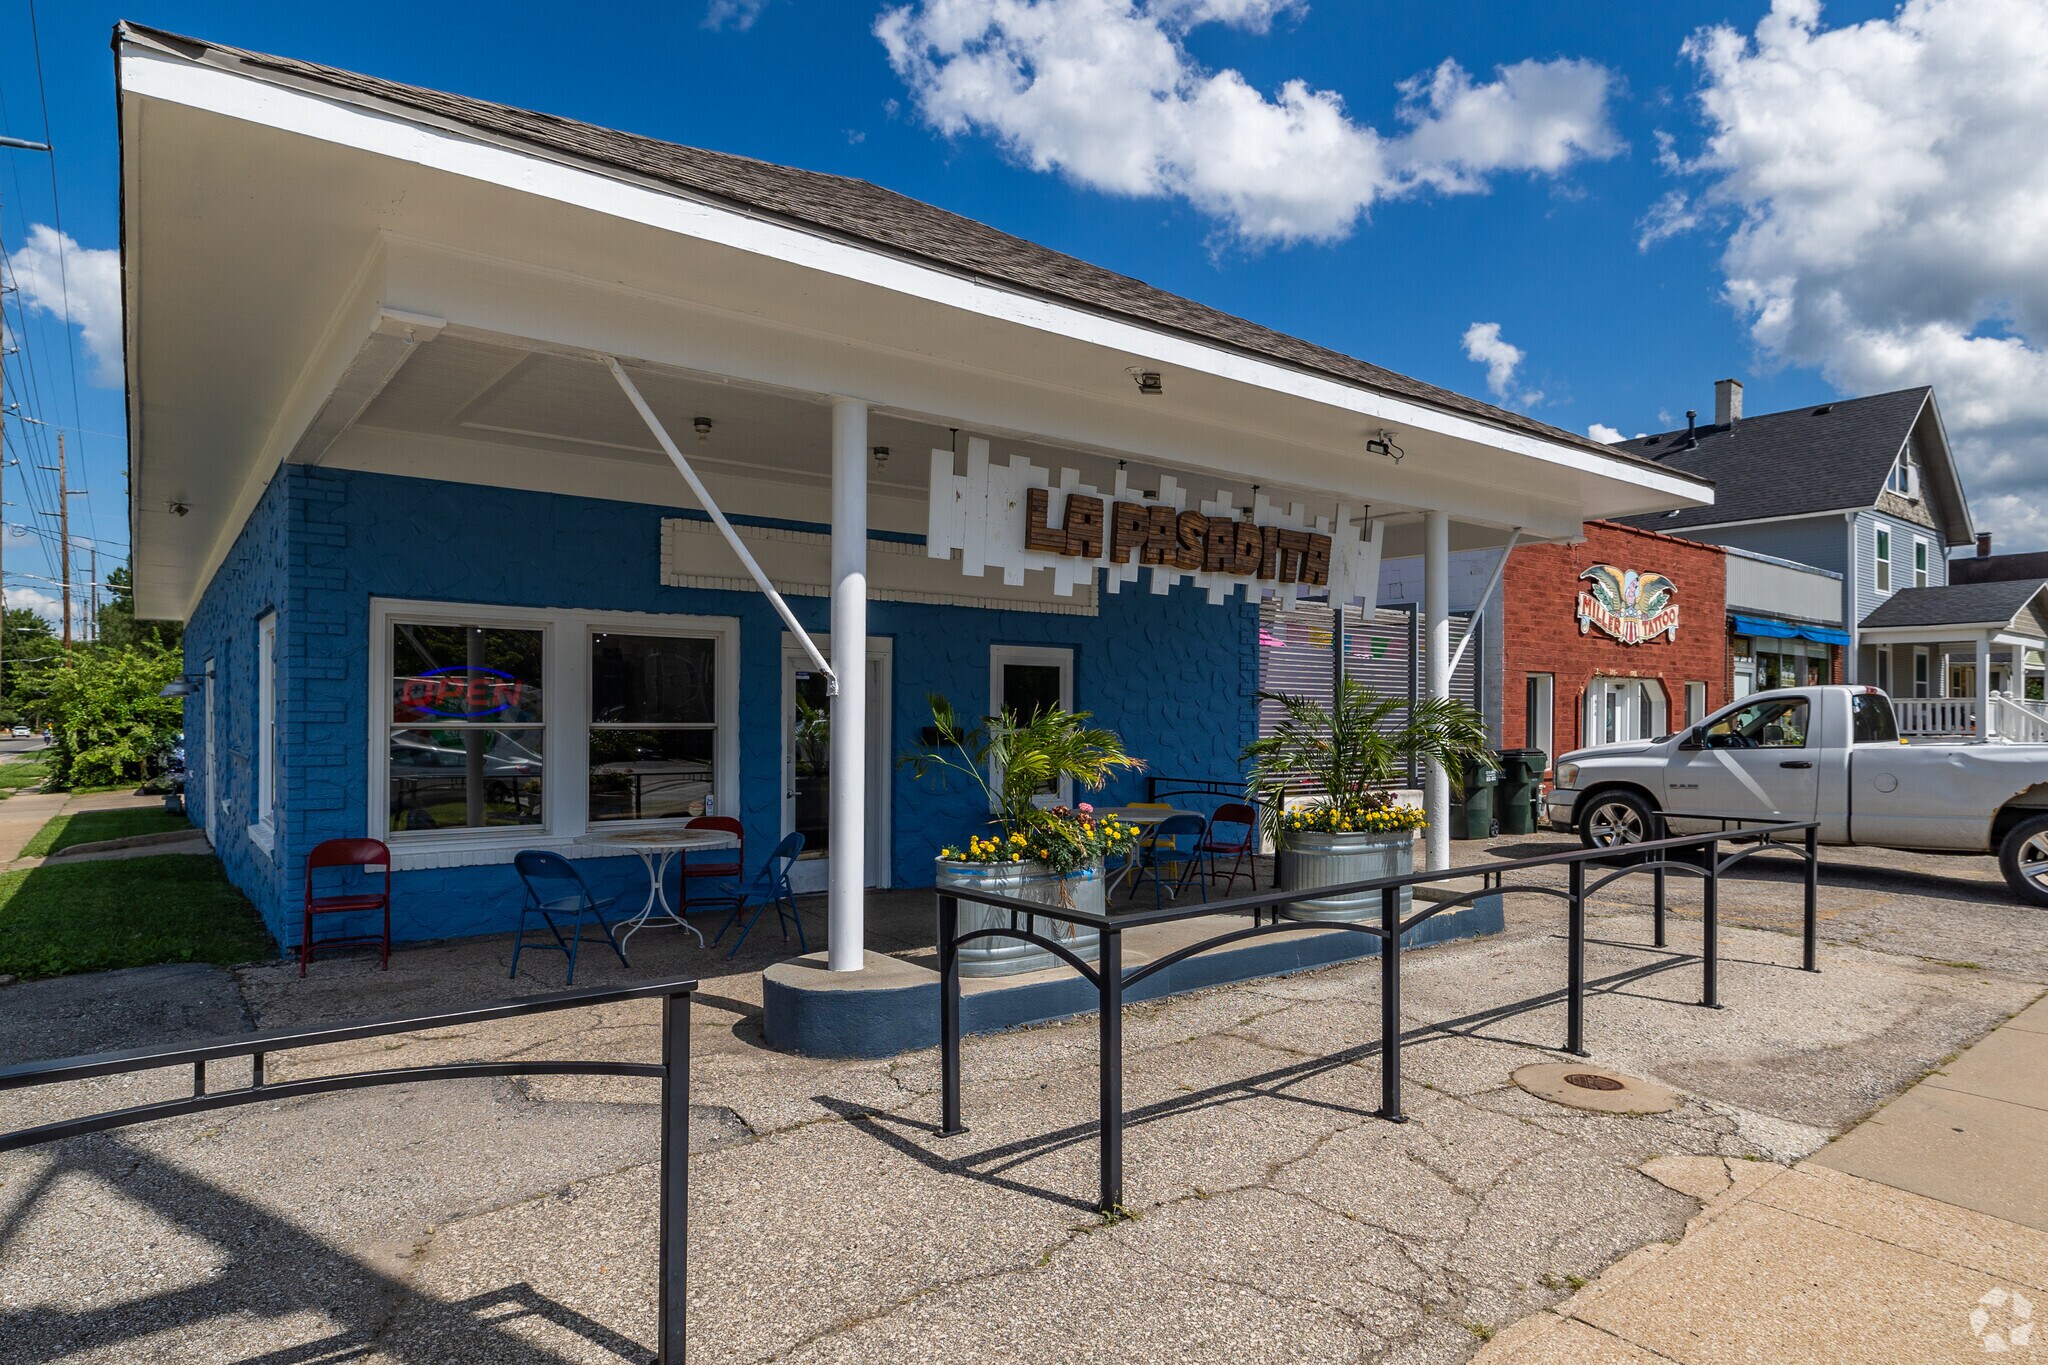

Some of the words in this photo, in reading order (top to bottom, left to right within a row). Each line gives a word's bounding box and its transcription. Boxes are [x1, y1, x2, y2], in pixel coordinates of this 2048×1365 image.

[1025, 487, 1103, 559] LA
[1110, 501, 1332, 586] PASADITA
[1582, 596, 1621, 634] MILLER
[1641, 608, 1676, 636] TATTOO
[401, 677, 524, 706] OPEN
